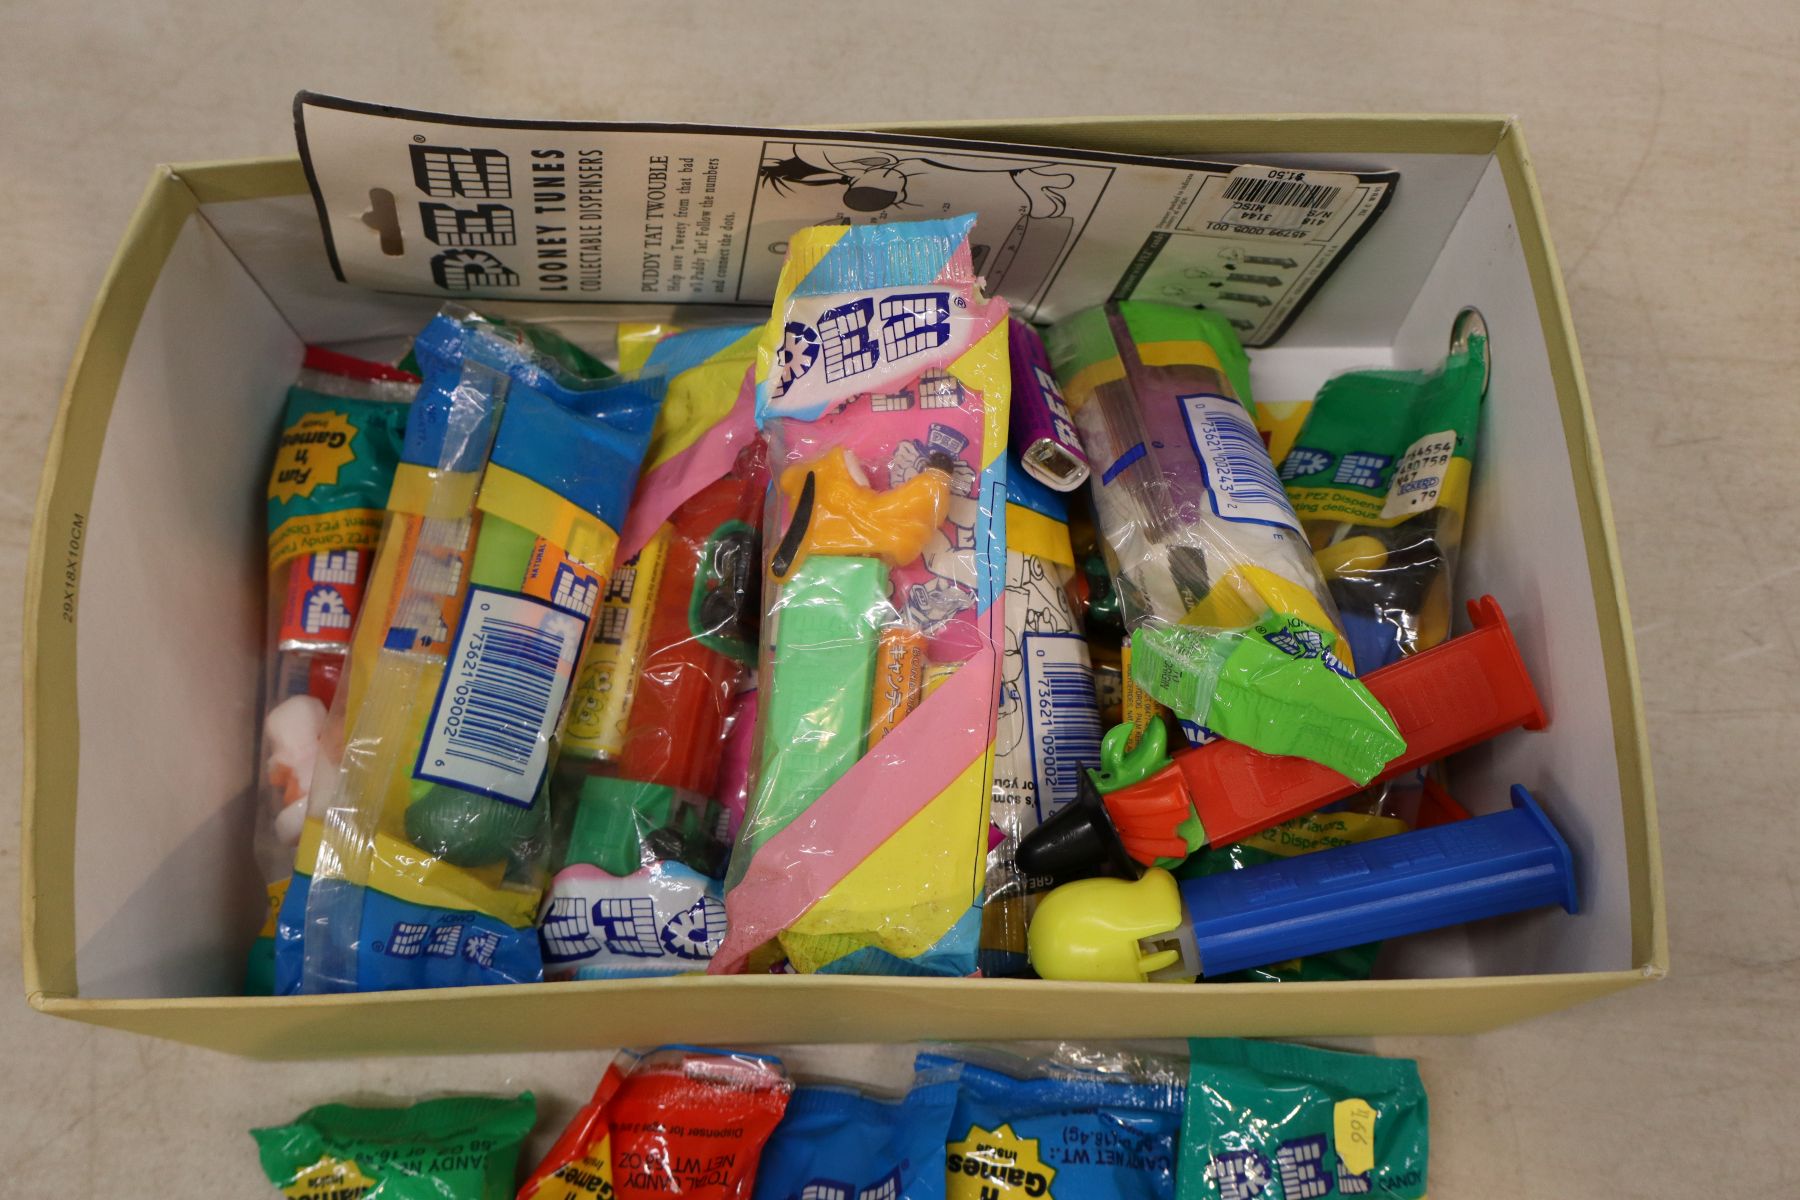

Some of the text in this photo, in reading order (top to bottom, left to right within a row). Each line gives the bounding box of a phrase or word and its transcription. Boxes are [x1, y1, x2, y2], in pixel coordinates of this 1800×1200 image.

[702, 158, 720, 193] numbers
[1267, 170, 1306, 181] $1.50
[409, 144, 520, 291] PEZ
[531, 149, 568, 291] LOONEY TUNES
[578, 150, 603, 291] COLLECTABLE DISPENSERS
[699, 194, 714, 208] the
[1241, 212, 1273, 222] 3144
[641, 155, 669, 293] PUDDY TAT TWOUBLE
[667, 157, 694, 292] Help save Tweety from that bad
[695, 211, 712, 237] Follow
[1206, 222, 1230, 232] 001
[1268, 230, 1308, 239] 45799
[691, 257, 710, 281] Puddy
[712, 212, 736, 293] and connect the dots.
[277, 467, 313, 485] Fun
[1202, 421, 1222, 454] 73621
[1212, 455, 1235, 492] 00243
[1279, 446, 1403, 490] PE
[300, 550, 360, 634] PE
[460, 632, 485, 679] 73621
[443, 684, 469, 738] 09002
[1038, 679, 1053, 726] 73621
[1041, 735, 1058, 786] 09002
[991, 794, 1022, 806] som
[385, 922, 501, 970] PEZ
[537, 895, 728, 964] PEZ
[670, 1123, 684, 1137] for
[688, 1125, 744, 1139] Dispenser
[684, 1170, 732, 1190] TOTAL
[706, 1153, 736, 1170] NET
[948, 1153, 1048, 1198] Games
[1378, 1170, 1422, 1192] CANDY
